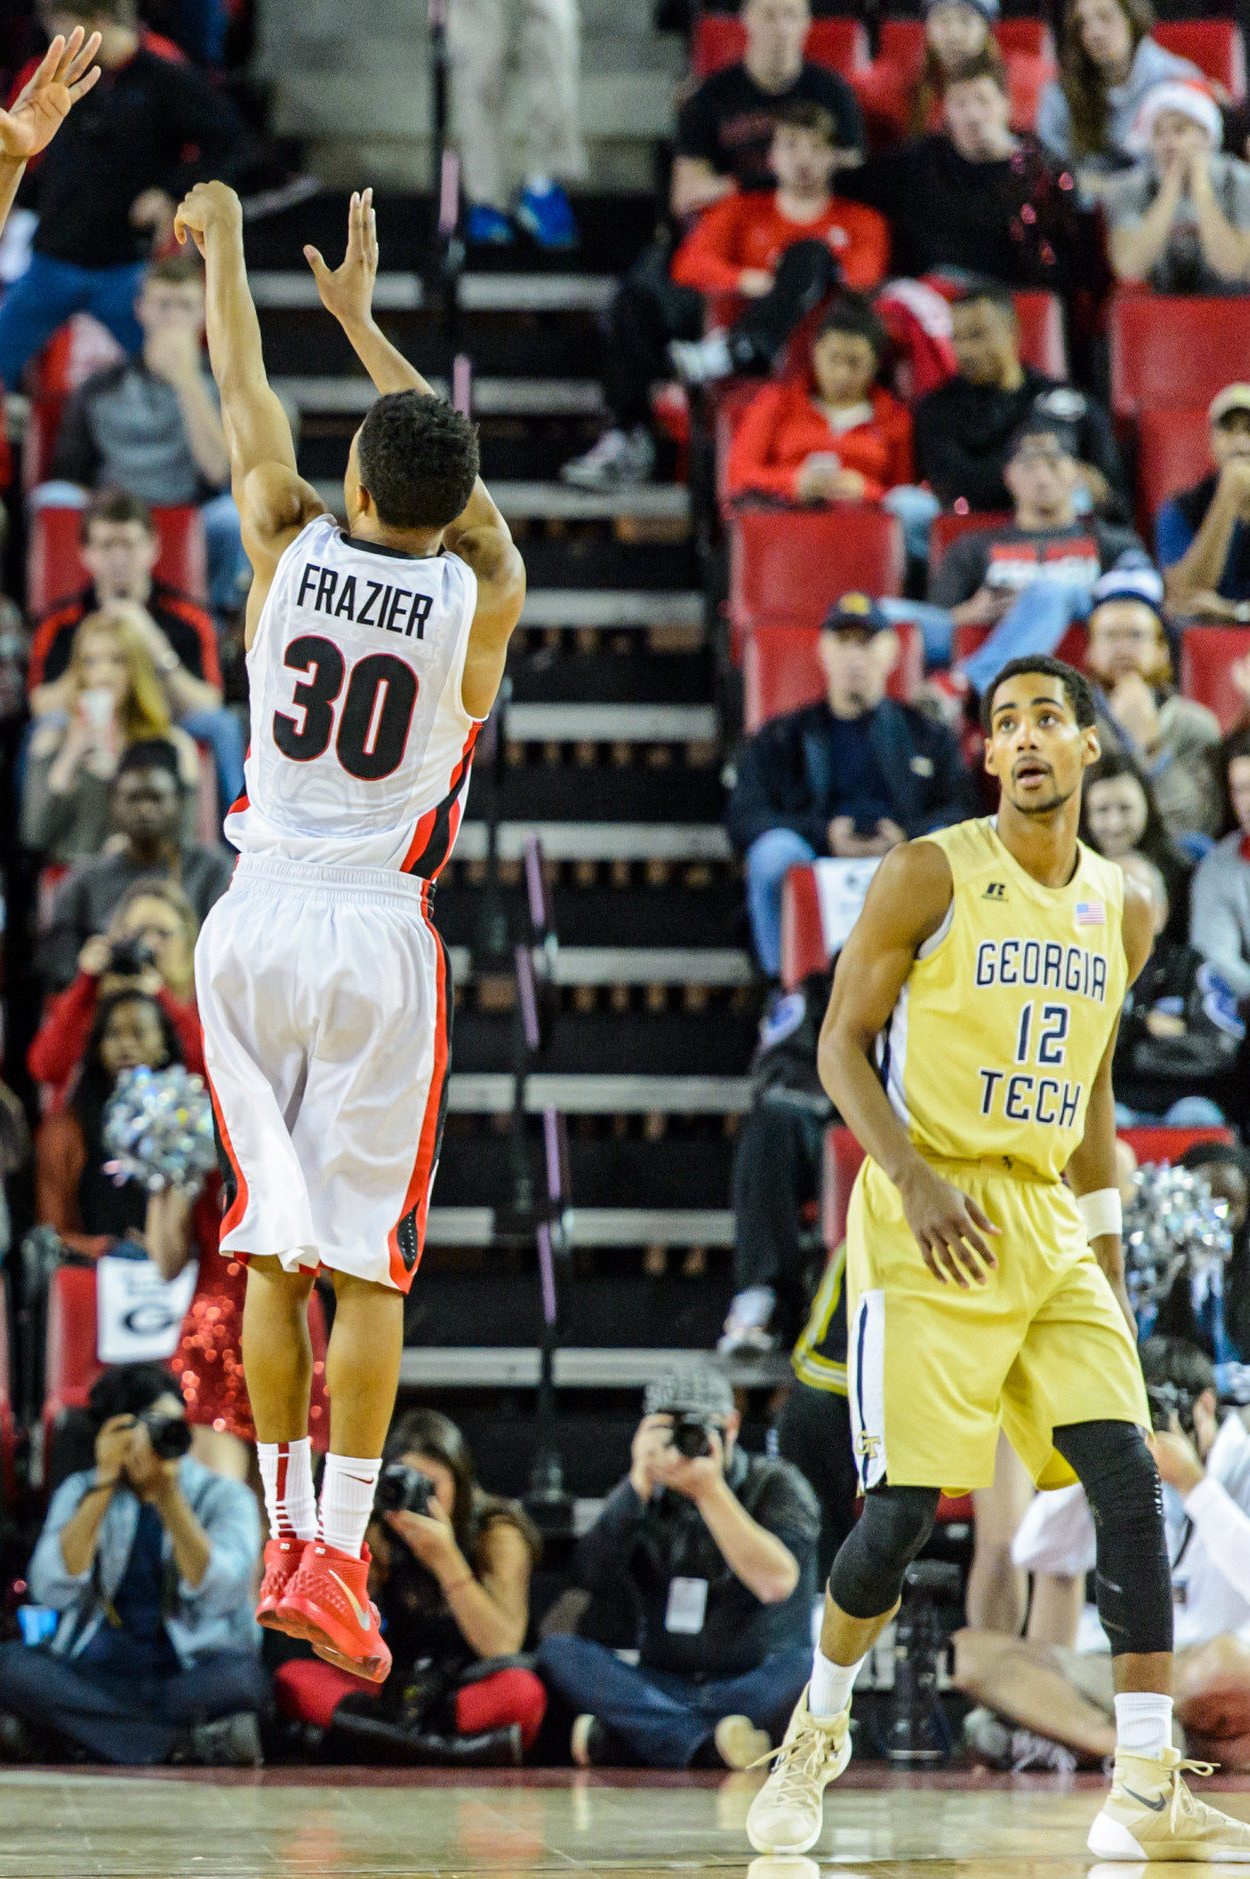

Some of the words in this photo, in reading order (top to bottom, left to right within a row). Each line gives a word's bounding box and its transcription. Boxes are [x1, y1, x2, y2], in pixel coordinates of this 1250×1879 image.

[296, 562, 435, 641] FRAZIER
[272, 633, 420, 782] 30
[975, 940, 1108, 1003] GEORGIA
[1016, 1003, 1069, 1064] 12
[979, 1069, 1082, 1129] TECH
